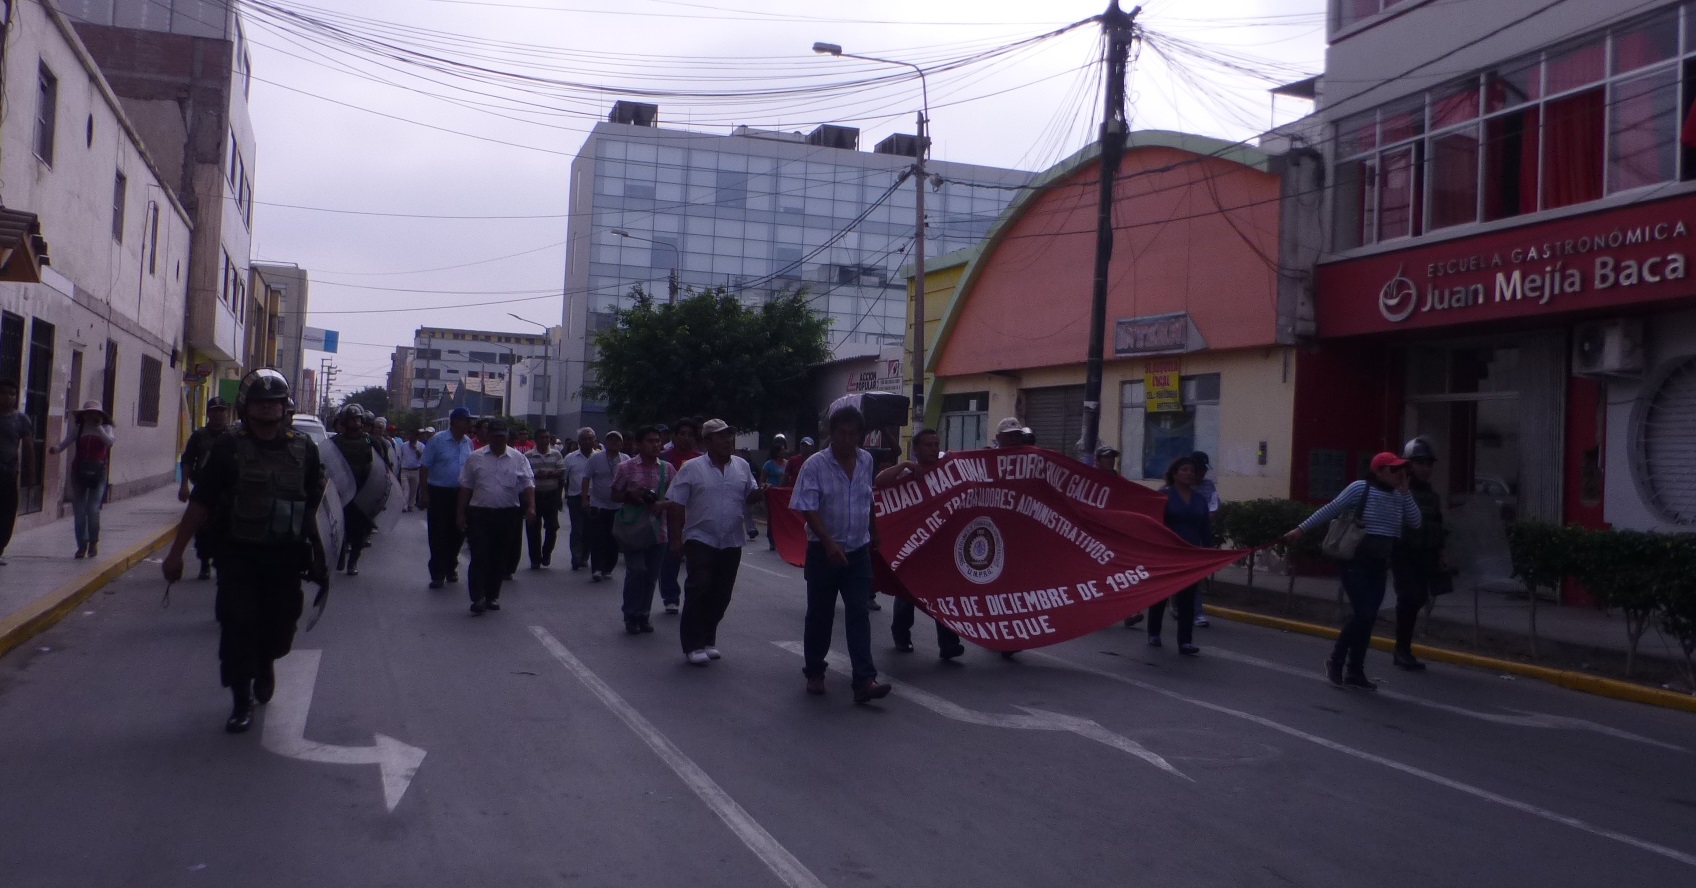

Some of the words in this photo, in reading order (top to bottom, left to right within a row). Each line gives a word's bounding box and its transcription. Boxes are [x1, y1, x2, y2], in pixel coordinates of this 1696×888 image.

[1427, 254, 1502, 278] ESCUELA
[1511, 219, 1688, 264] GASTRONÓMICA
[1421, 283, 1485, 313] Juan
[1494, 261, 1582, 305] Mejía
[1593, 252, 1686, 290] Baca
[924, 457, 993, 498] NACIONAL
[1046, 461, 1070, 493] RUIZ
[1065, 474, 1110, 509] GALLO
[1016, 494, 1115, 565] ADMINISTRATIVOS
[936, 596, 959, 617] 03
[966, 596, 984, 617] DE
[987, 586, 1075, 616] DICIEMBRE
[1077, 580, 1103, 601] DE
[1105, 564, 1150, 592] 1966
